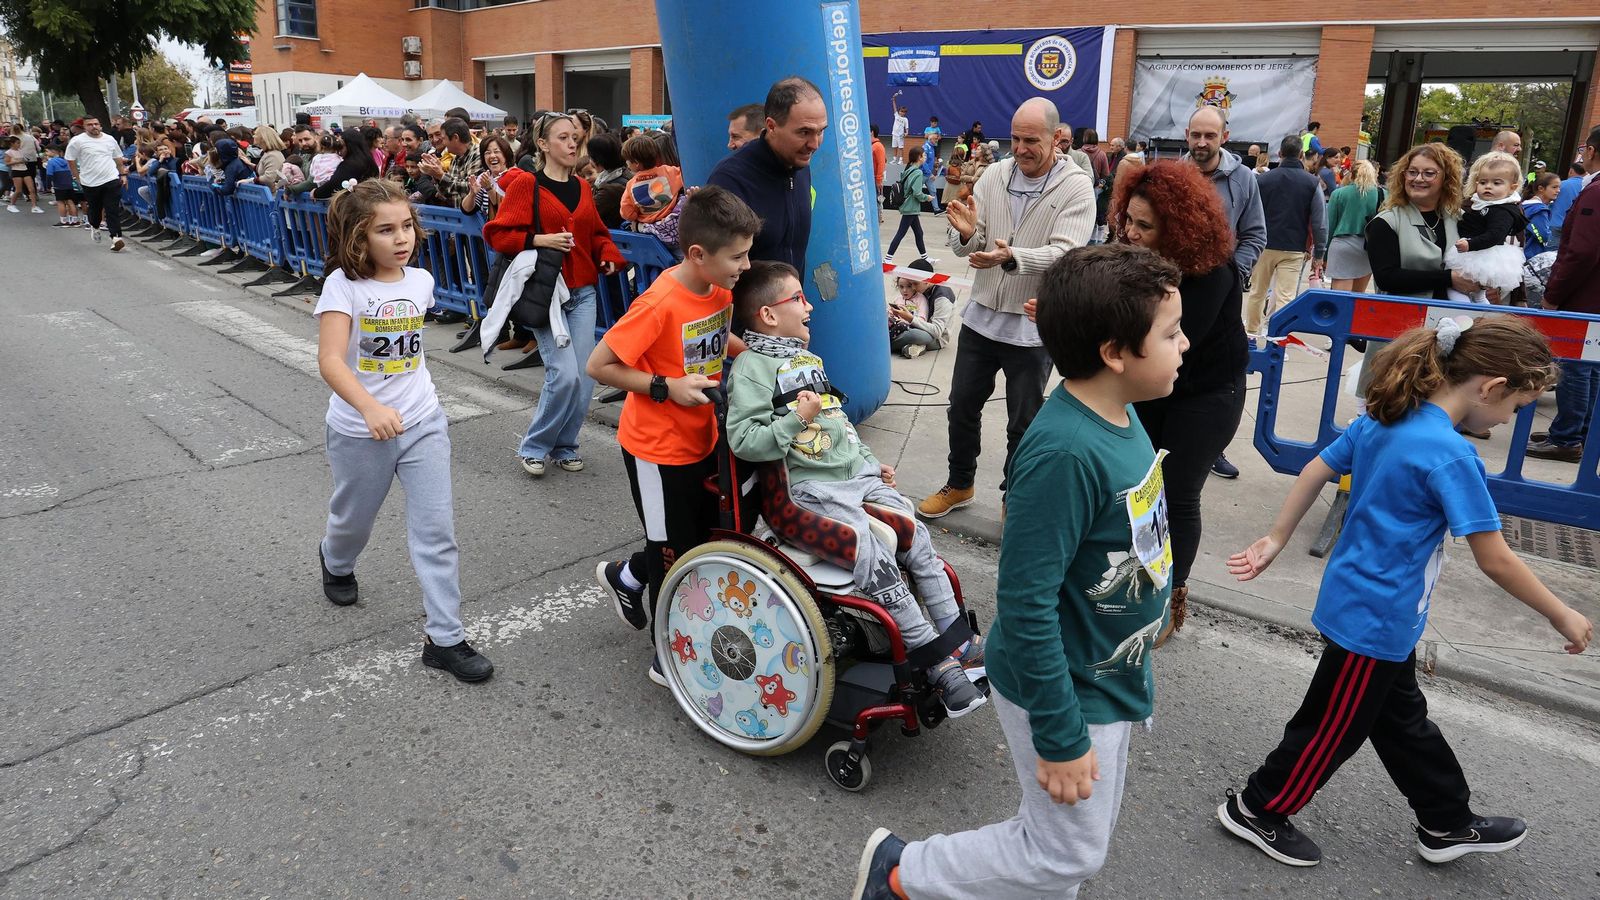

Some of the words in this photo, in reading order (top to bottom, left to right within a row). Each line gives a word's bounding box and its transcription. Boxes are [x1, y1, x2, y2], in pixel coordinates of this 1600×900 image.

[1149, 62, 1204, 71] AGRUPACIÓN
[1254, 63, 1267, 71] DE
[831, 9, 871, 264] deportes@aytojerez.es
[364, 318, 390, 326] CARRERA
[687, 320, 708, 331] CARRERA
[375, 324, 403, 333] BOMBEROS
[373, 333, 420, 357] 216
